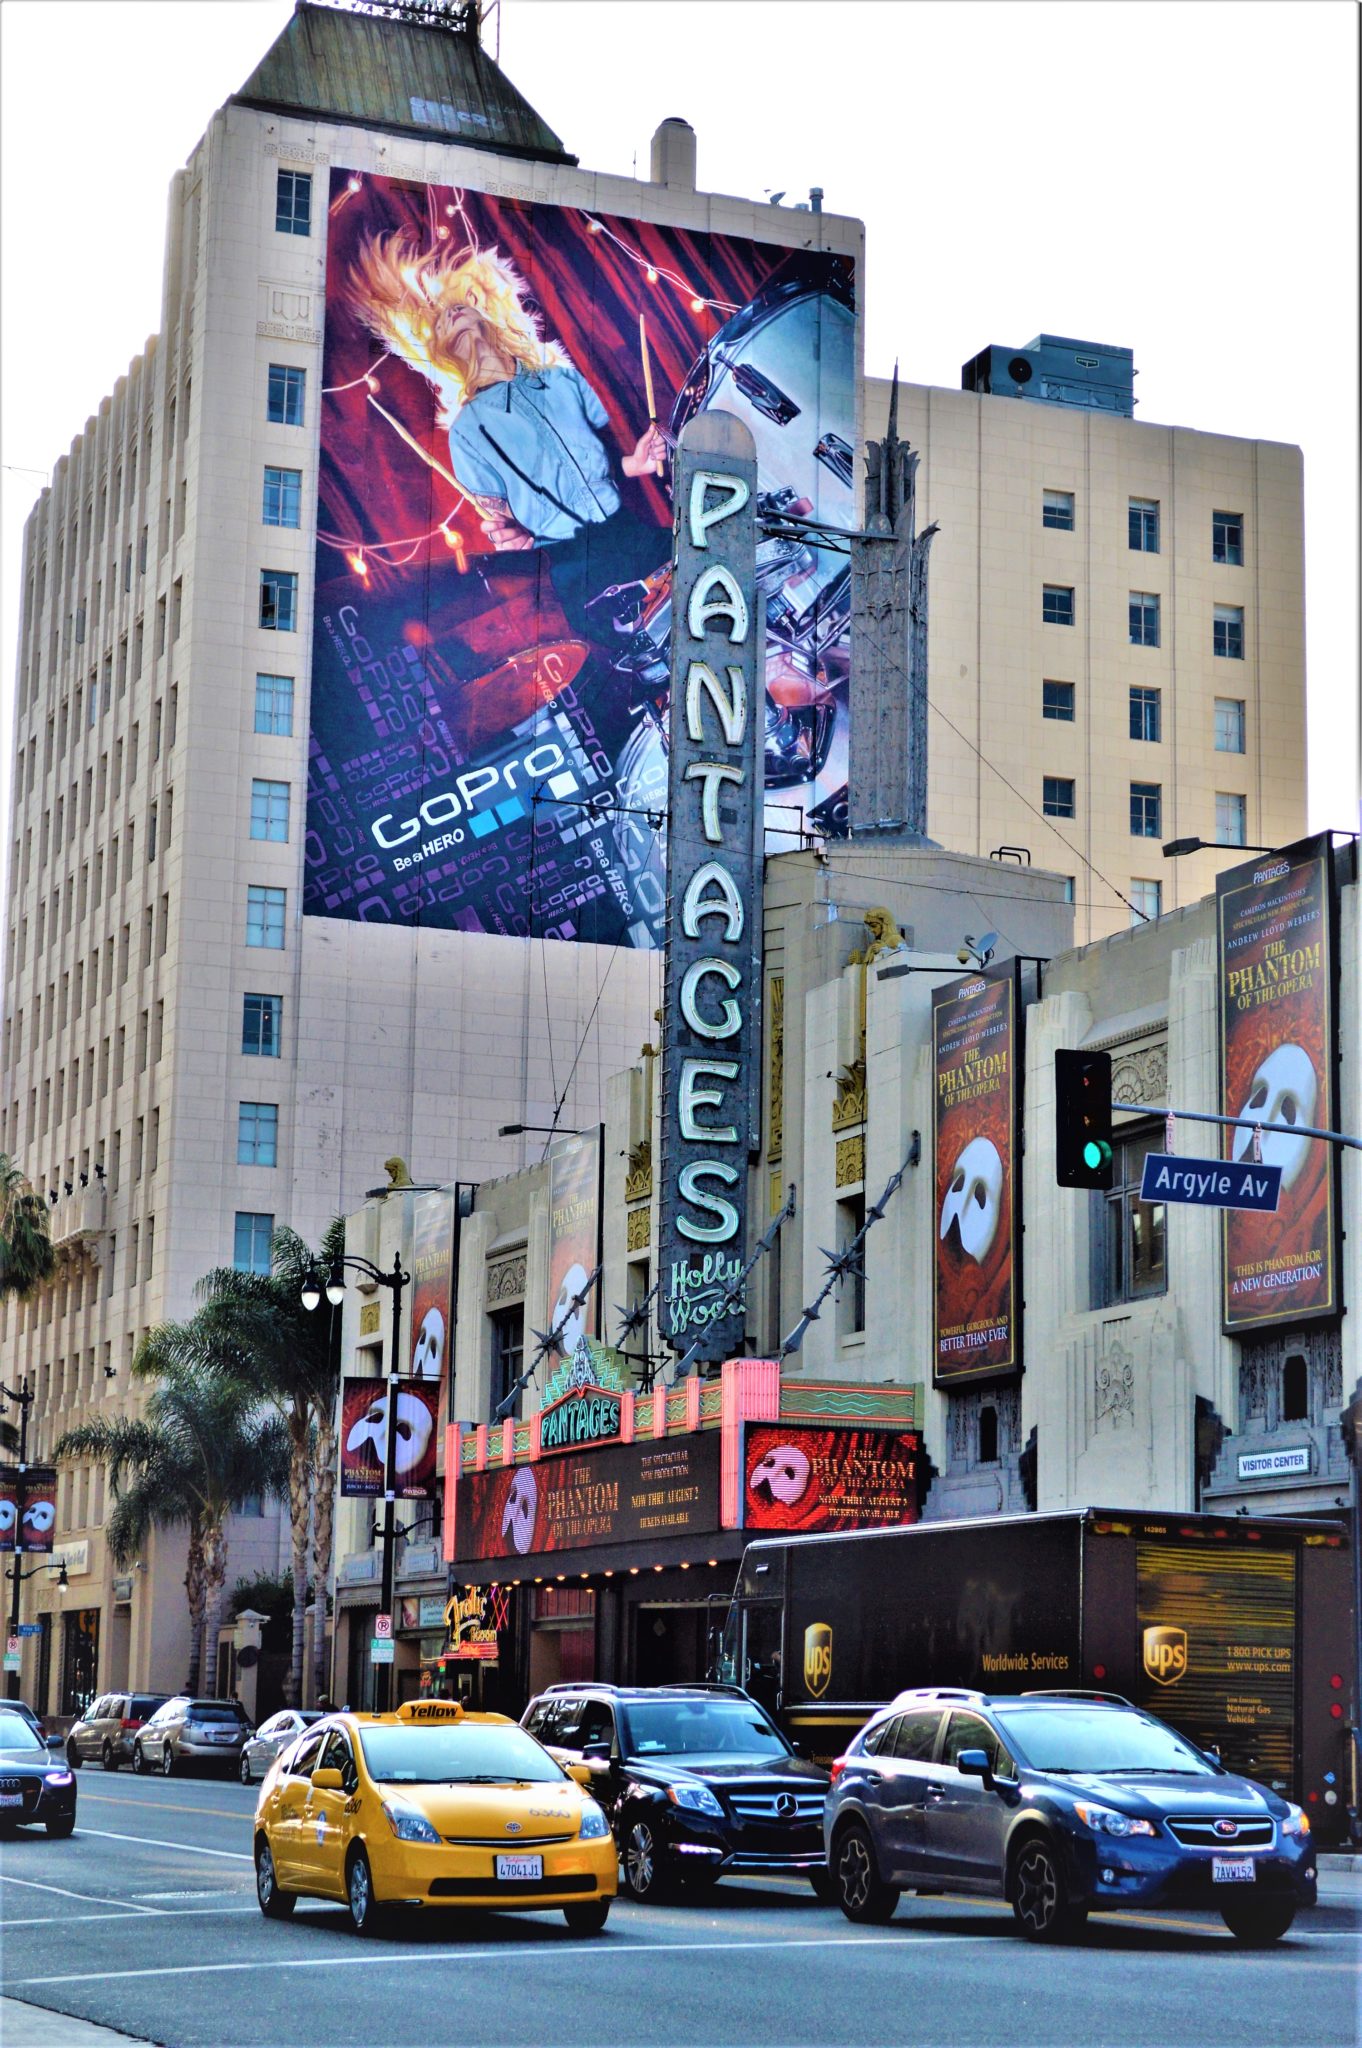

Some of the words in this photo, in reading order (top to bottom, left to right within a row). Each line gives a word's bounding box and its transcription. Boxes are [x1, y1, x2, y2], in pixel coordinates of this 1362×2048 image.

[371, 744, 565, 849] GoPro
[393, 856, 413, 872] Be
[412, 852, 425, 863] a
[421, 828, 465, 858] HERO
[590, 837, 605, 858] Be
[676, 470, 749, 1243] PANTAGES
[1253, 861, 1290, 885] PANTAGES
[1240, 902, 1266, 917] CAMERON
[1227, 932, 1259, 949] ANDREW
[1261, 922, 1285, 938] LLOYD
[1287, 909, 1320, 928] WEBBER'S
[1263, 938, 1286, 959] THE
[1228, 942, 1320, 998] PHANTOM
[958, 981, 986, 999] PANTAGES
[1237, 992, 1254, 1010] OF
[1255, 984, 1276, 1006] THE
[1277, 974, 1313, 998] OPERA
[938, 1040, 961, 1054] ANDREW
[962, 1032, 980, 1046] LLOYD
[963, 1047, 981, 1064] THE
[938, 1051, 1007, 1096] PHANTOM
[944, 1092, 955, 1107] OF
[957, 1087, 973, 1103] THE
[972, 1077, 1001, 1098] OPERA
[1155, 1166, 1231, 1198] Argyle
[1239, 1174, 1269, 1198] Av
[553, 1197, 594, 1229] PHANTOM
[1256, 1261, 1263, 1273] IS
[1264, 1253, 1304, 1271] PHANTOM
[1305, 1249, 1322, 1262] FOR
[671, 1251, 744, 1298] Holly
[1232, 1281, 1240, 1295] A
[1240, 1275, 1261, 1293] NEW
[997, 1315, 1009, 1325] AND
[940, 1335, 966, 1352] BETTER
[966, 1330, 987, 1347] THAN
[541, 1398, 620, 1447] PANTAGES
[344, 1468, 381, 1478] PHANTOM
[812, 1458, 916, 1480] PHANTOM
[1242, 1459, 1273, 1472] VISITOR
[1273, 1454, 1304, 1468] CENTER
[574, 1467, 592, 1485] THE
[820, 1476, 837, 1487] OF
[840, 1477, 864, 1488] THE
[866, 1478, 905, 1489] OPERA
[547, 1482, 619, 1519] PHANTOM
[631, 1494, 646, 1509] NOW
[647, 1491, 665, 1506] THRU
[667, 1487, 694, 1503] AUGUST
[818, 1495, 839, 1504] NOW
[867, 1496, 901, 1507] AUGUST
[829, 1508, 859, 1517] TICKETS
[860, 1509, 900, 1519] AVAILABLE
[553, 1523, 564, 1537] OF
[567, 1520, 582, 1535] THE
[582, 1515, 612, 1535] OPERA
[982, 1653, 1028, 1673] Worldwide
[1031, 1652, 1069, 1671] Services
[1146, 1644, 1185, 1676] ups
[1233, 1646, 1250, 1657] 800
[1252, 1647, 1272, 1658] PICK
[1274, 1648, 1291, 1659] UPS
[808, 1646, 831, 1687] ups
[1227, 1662, 1291, 1674] www.ups.com
[410, 1705, 458, 1718] Yellow
[1227, 1704, 1255, 1713] Natural
[1257, 1705, 1271, 1714] Gas
[1227, 1714, 1255, 1724] Vehicle
[500, 1864, 540, 1877] 47041J1
